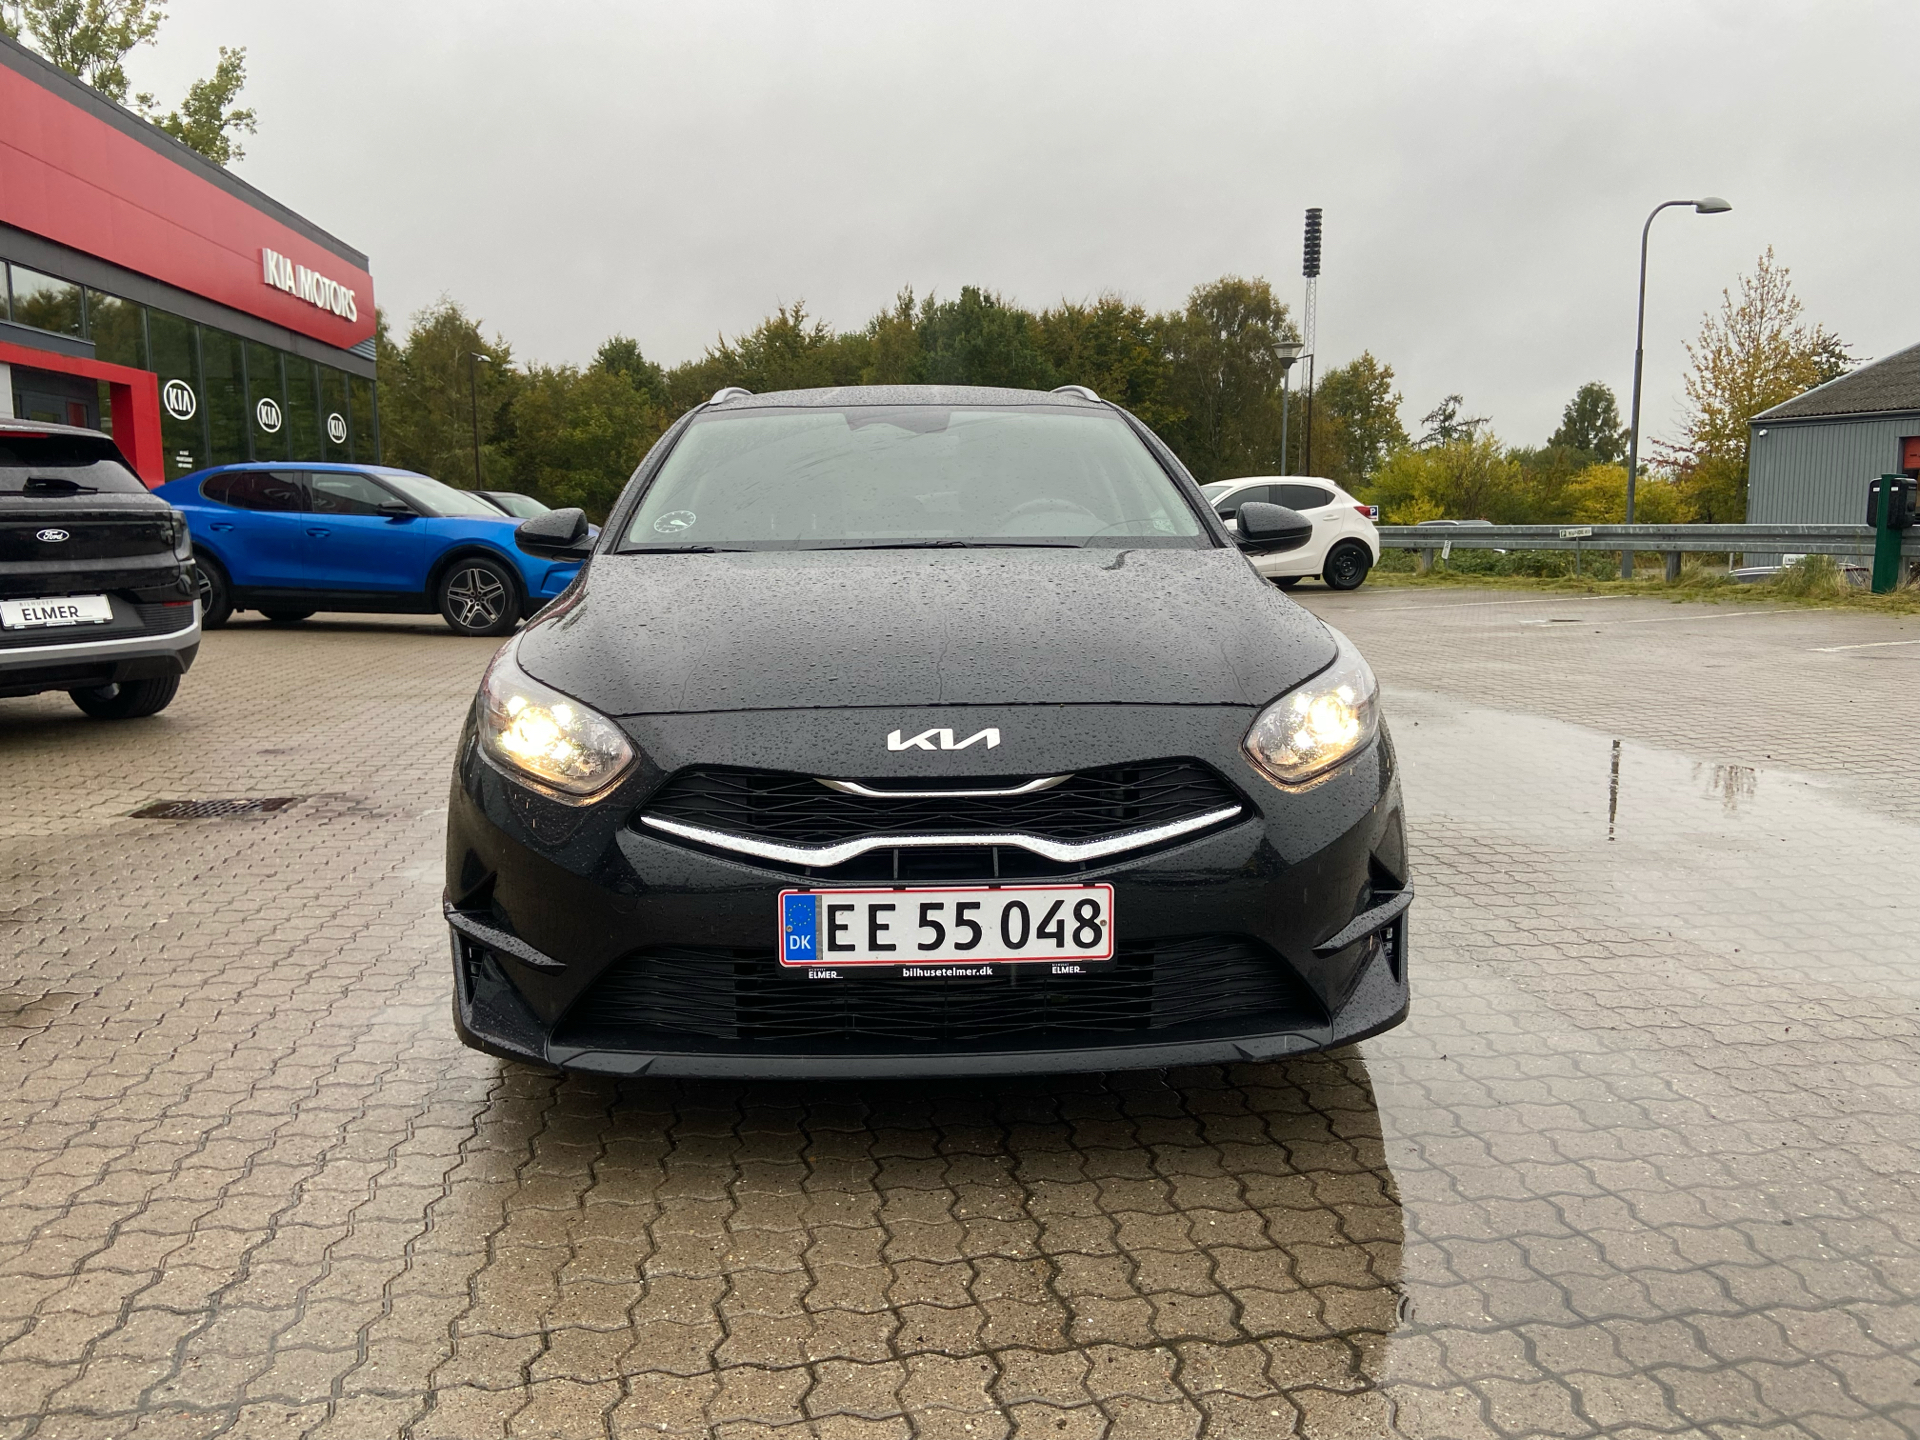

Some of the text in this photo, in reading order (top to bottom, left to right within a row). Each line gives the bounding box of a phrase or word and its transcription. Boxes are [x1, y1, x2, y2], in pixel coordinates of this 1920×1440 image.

[262, 248, 357, 323] KIA MOTORS
[168, 388, 191, 412] KIA
[261, 408, 279, 428] KIA
[330, 421, 345, 437] KIA
[43, 530, 63, 540] Ford
[21, 605, 79, 621] ELMER
[887, 728, 1001, 751] KIA
[827, 898, 1103, 953] EE 55 048
[789, 935, 811, 951] DK
[808, 971, 837, 979] ELMER
[903, 967, 993, 977] bilhusetelmer.dk
[1052, 966, 1080, 974] ELMER
